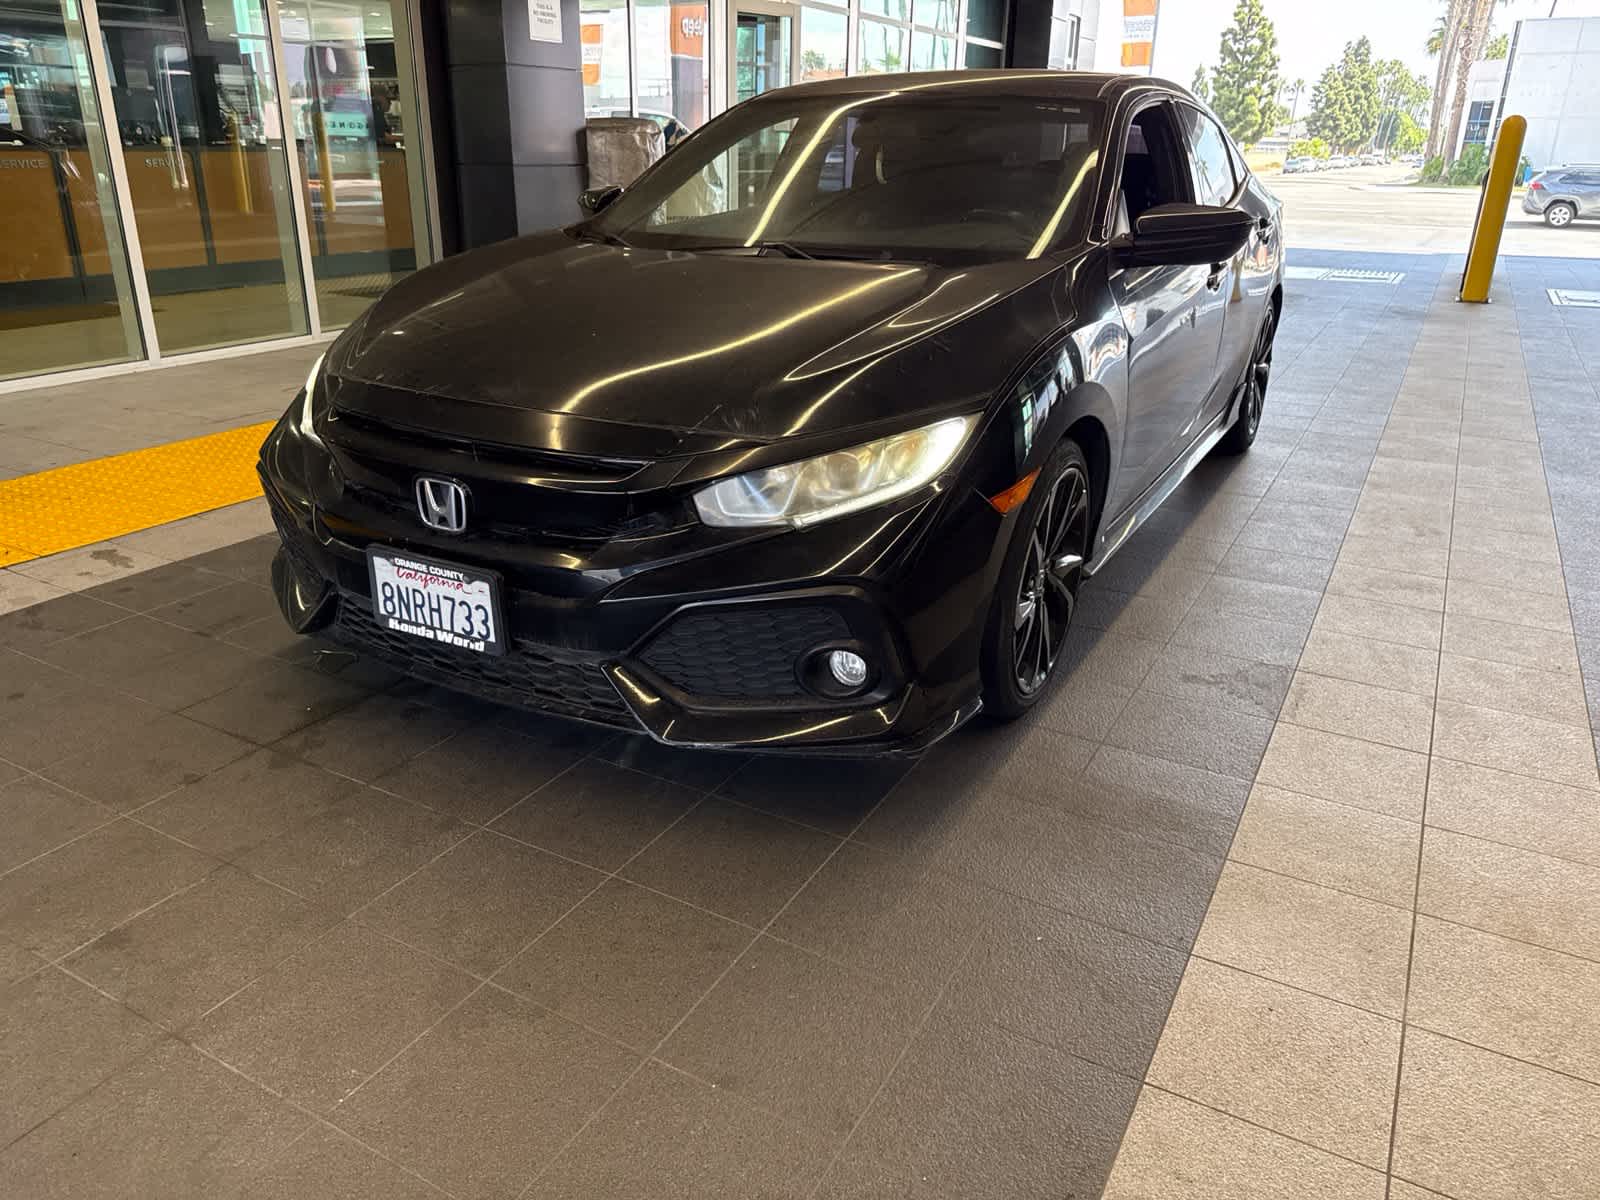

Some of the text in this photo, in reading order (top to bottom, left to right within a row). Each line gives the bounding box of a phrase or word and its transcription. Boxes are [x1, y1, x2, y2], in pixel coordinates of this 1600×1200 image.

[394, 557, 464, 581] ORANGE COUNTY
[381, 581, 491, 640] 8NRH733
[388, 618, 435, 640] Honda
